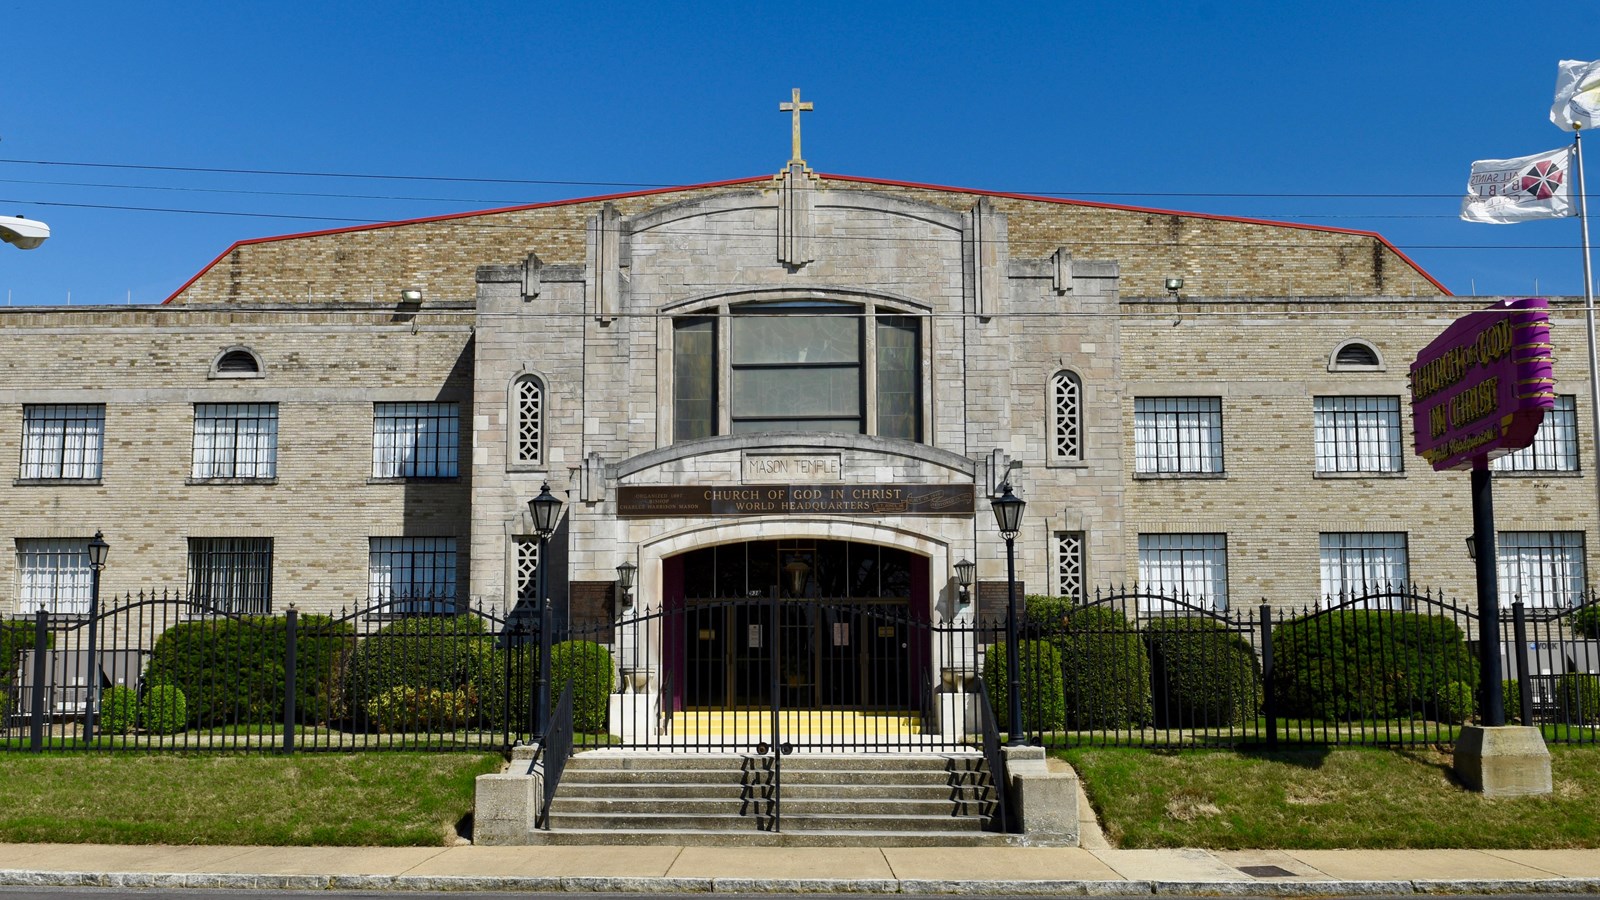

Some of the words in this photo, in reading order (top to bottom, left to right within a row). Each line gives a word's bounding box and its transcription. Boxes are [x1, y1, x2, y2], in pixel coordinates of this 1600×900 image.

[1411, 346, 1465, 400] CHURCH
[1476, 319, 1513, 365] GOD
[1429, 402, 1447, 438] IN
[1449, 376, 1498, 428] CHRIST
[749, 459, 789, 474] MASON
[794, 459, 838, 474] TEMPLE
[703, 489, 760, 500] CHURCH
[767, 489, 785, 500] OF
[793, 488, 822, 500] GOD
[831, 488, 844, 500] IN
[852, 488, 902, 500] CHRIST
[736, 501, 775, 511] WORLD
[781, 501, 870, 512] HEADQUARTERS
